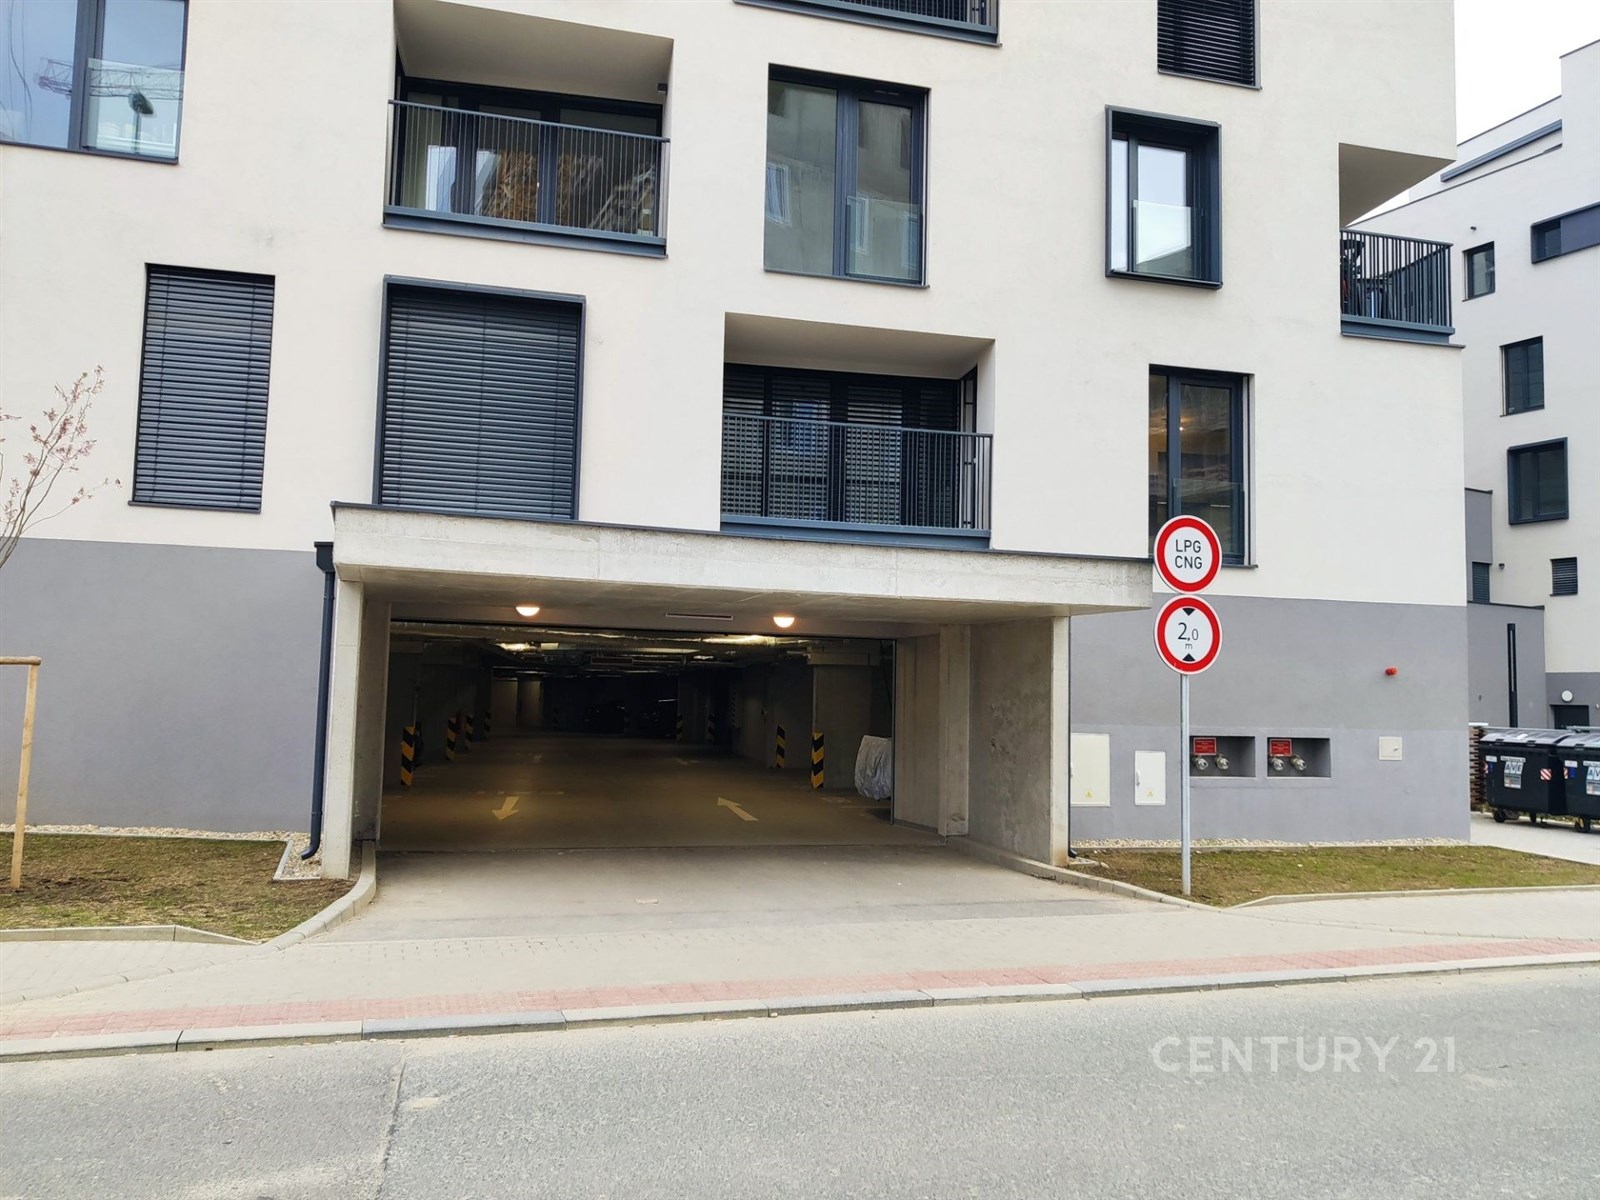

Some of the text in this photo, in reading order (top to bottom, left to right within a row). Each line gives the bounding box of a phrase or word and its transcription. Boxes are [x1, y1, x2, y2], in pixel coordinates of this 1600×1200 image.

[1175, 539, 1202, 554] LPG
[1175, 556, 1203, 570] CNG
[1177, 622, 1199, 641] 2,0
[1505, 762, 1522, 773] AVE
